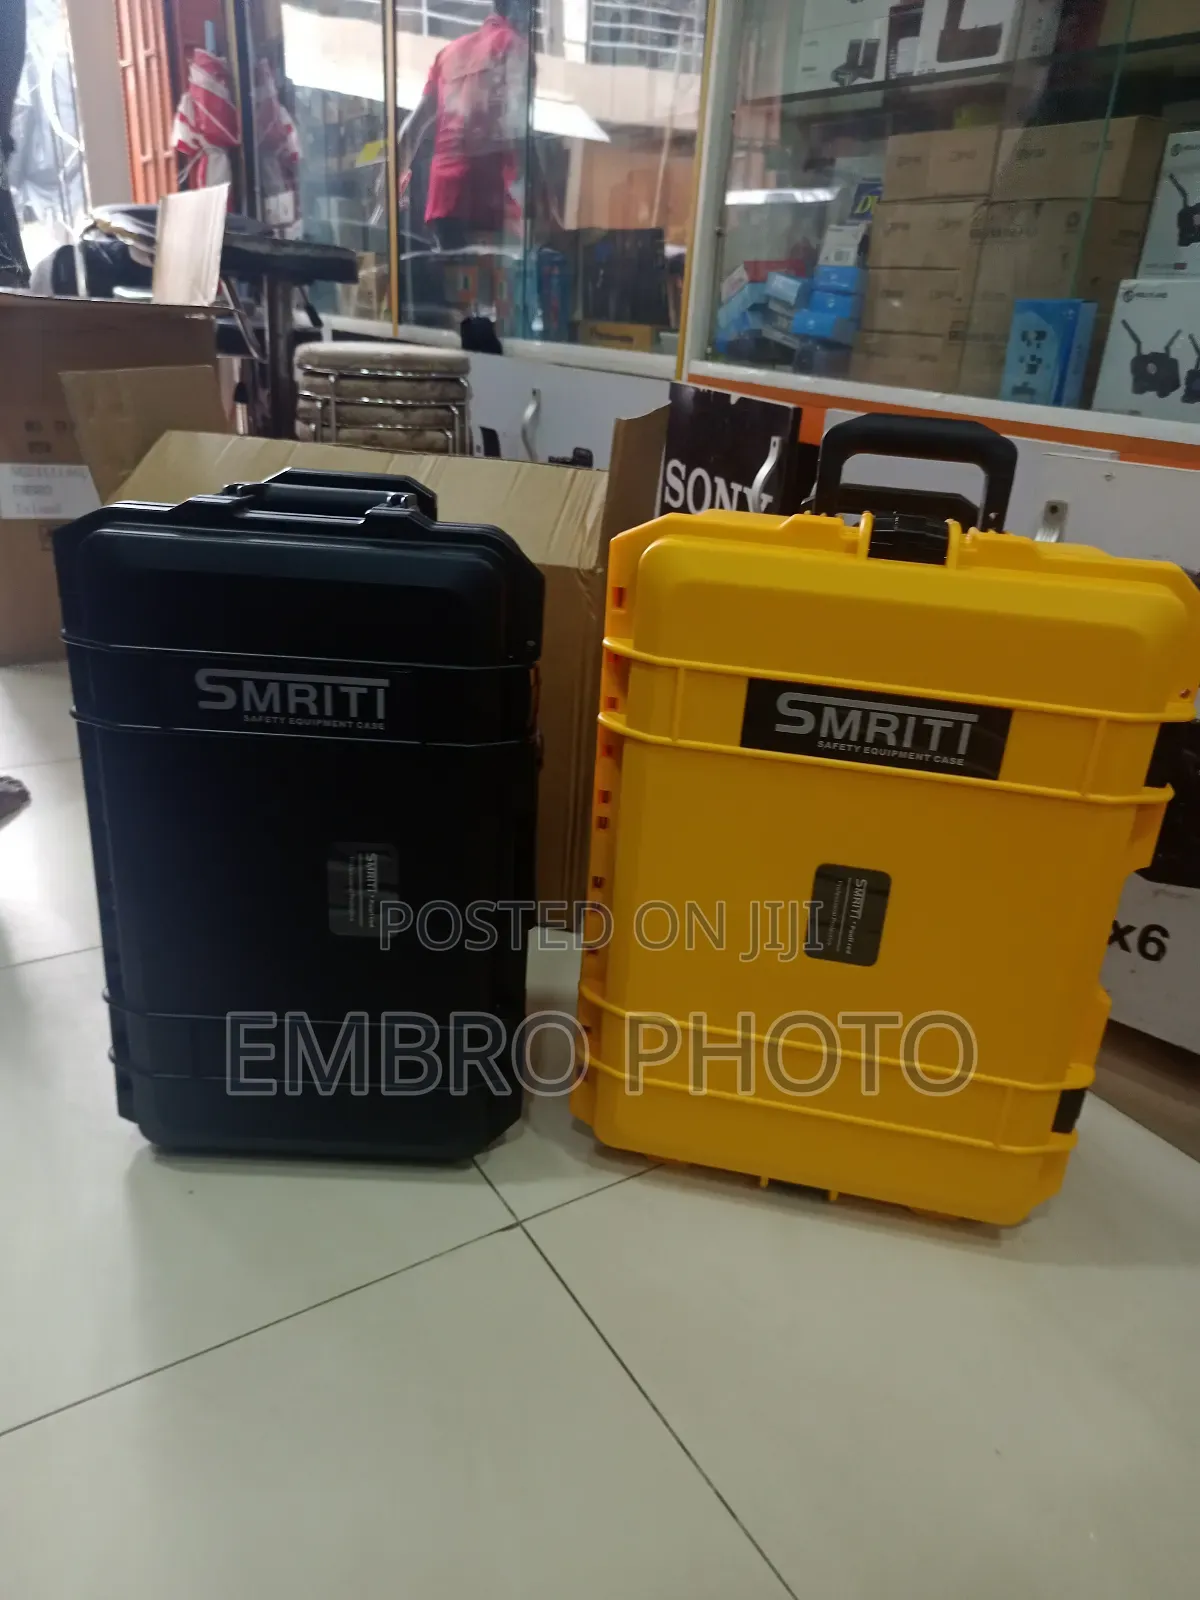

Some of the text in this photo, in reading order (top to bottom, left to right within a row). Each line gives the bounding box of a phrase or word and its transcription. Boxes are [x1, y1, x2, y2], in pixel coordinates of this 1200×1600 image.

[194, 668, 390, 719] SMRITI
[243, 714, 386, 731] SAFETY EQUIPMENT CASE
[774, 691, 979, 755] SMRITI
[816, 740, 966, 767] SAFETY EQUIPMENT CASE
[849, 878, 868, 920] SMRITI
